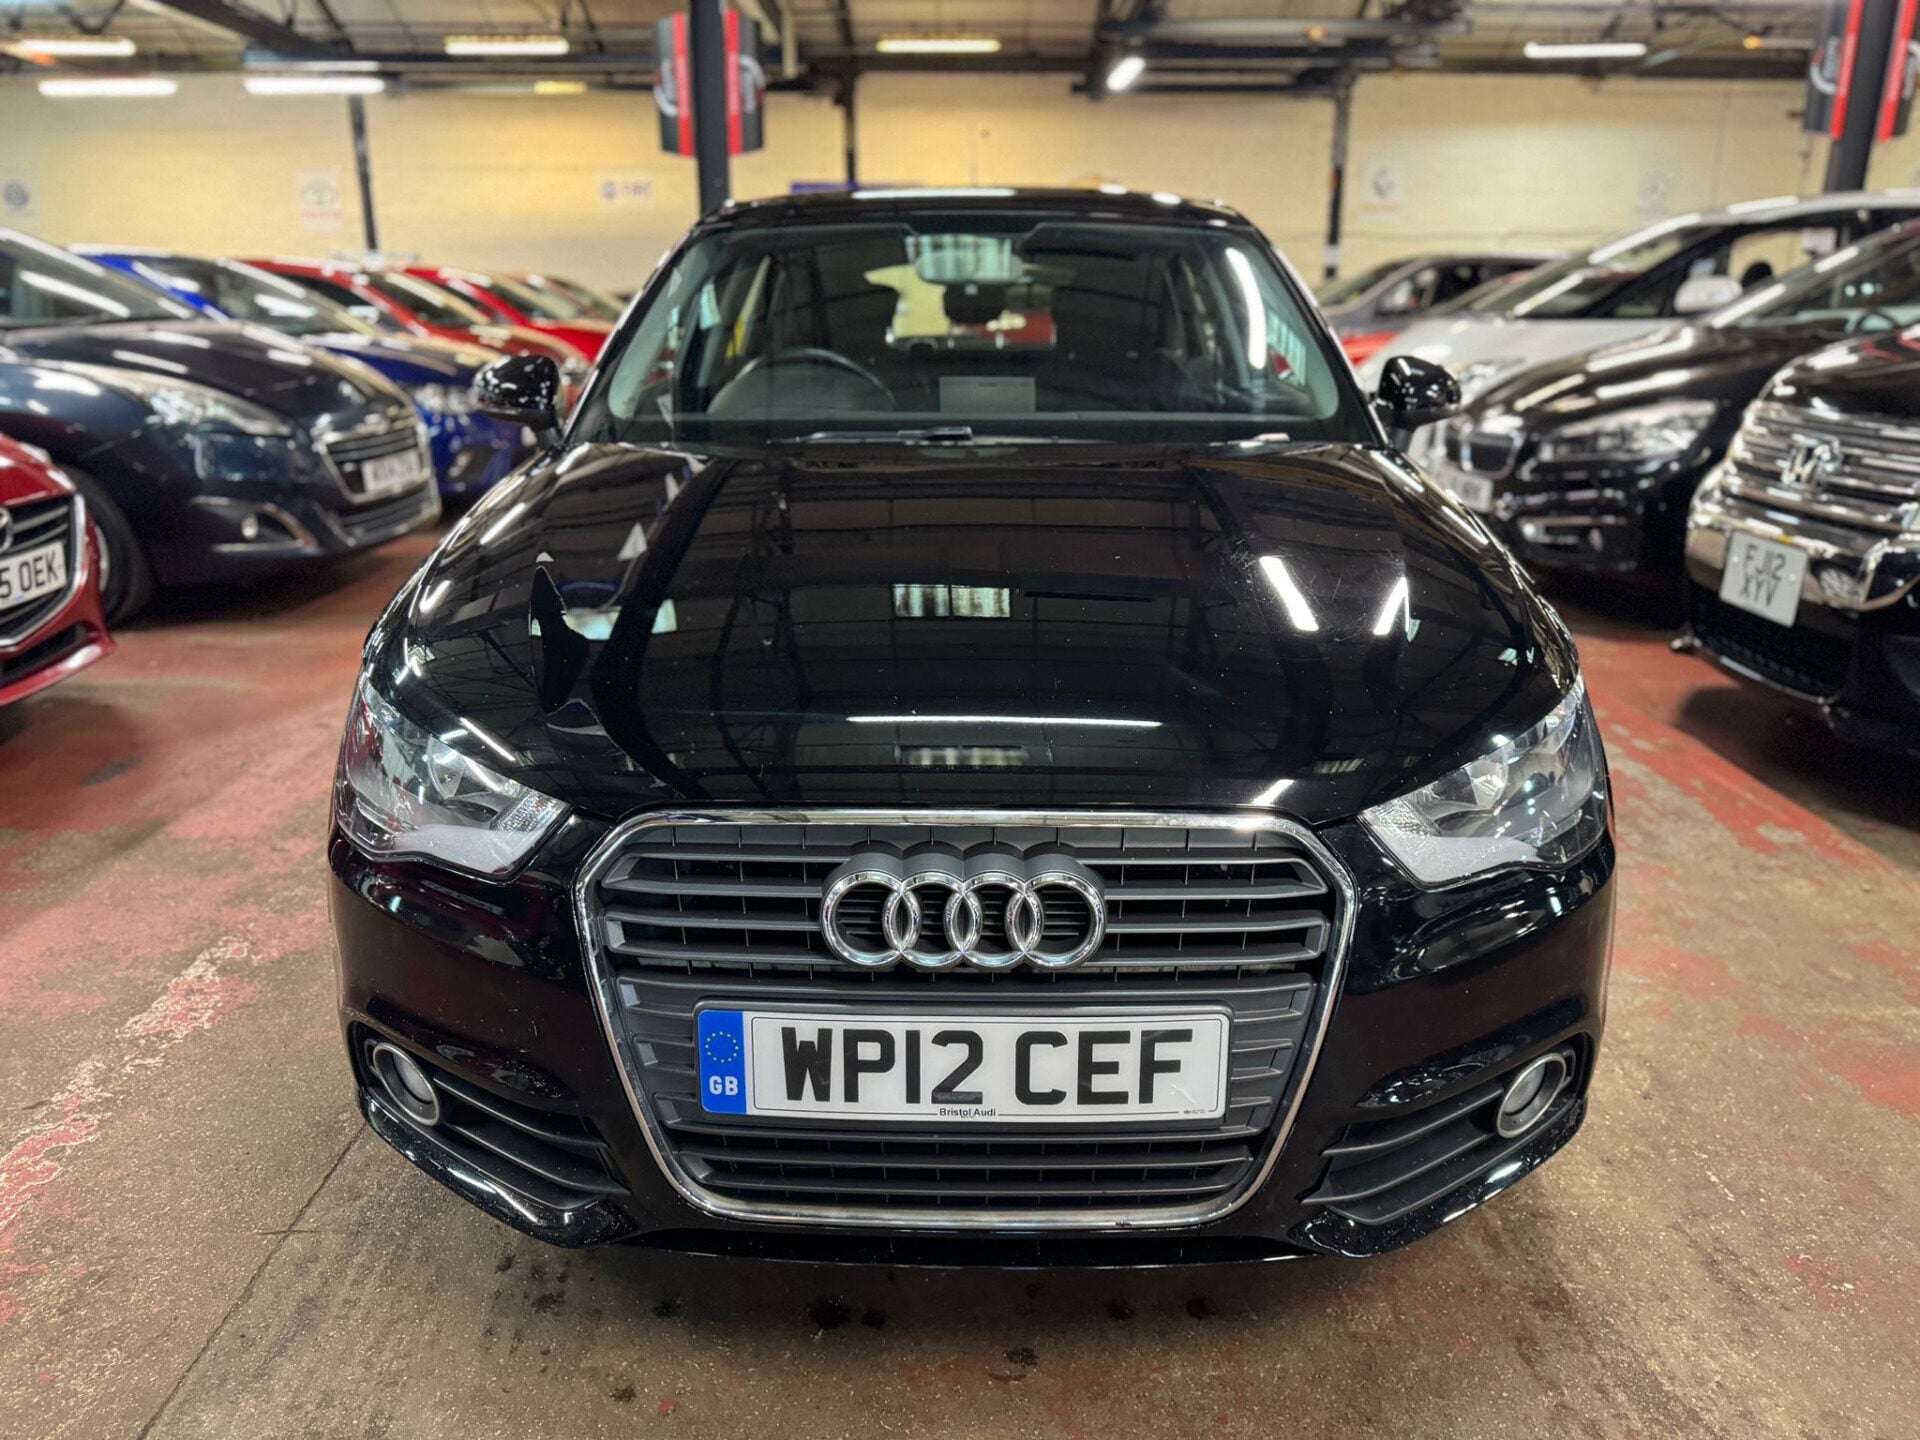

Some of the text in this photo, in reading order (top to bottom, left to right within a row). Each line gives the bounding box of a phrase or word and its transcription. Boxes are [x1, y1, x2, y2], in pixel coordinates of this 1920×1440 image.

[19, 550, 58, 592] OEK
[781, 1027, 1193, 1105] WP12 CEF
[709, 1075, 739, 1096] GB
[939, 1107, 996, 1117] Bristol Audi
